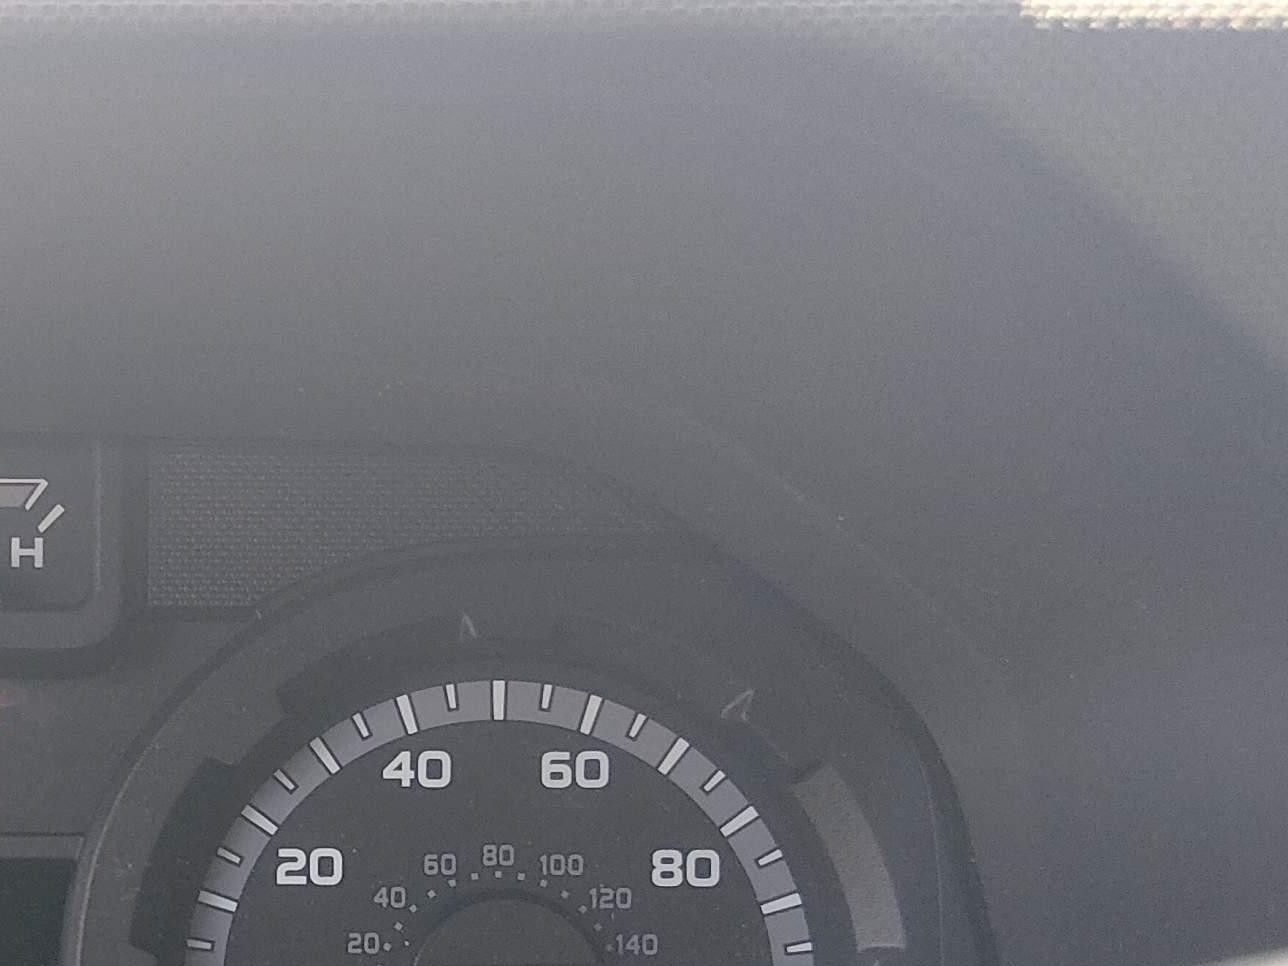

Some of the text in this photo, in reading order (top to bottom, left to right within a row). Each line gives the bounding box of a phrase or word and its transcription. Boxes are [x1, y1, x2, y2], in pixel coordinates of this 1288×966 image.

[11, 537, 44, 568] H
[382, 751, 452, 789] 40
[540, 750, 610, 789] 60
[275, 847, 343, 886] 20
[422, 852, 457, 876] 60
[482, 844, 514, 867] 80
[539, 853, 584, 877] 100
[651, 849, 721, 888] 80
[373, 886, 407, 910] 40
[588, 886, 632, 910] 120
[346, 932, 380, 956] 20
[615, 933, 658, 956] 140
